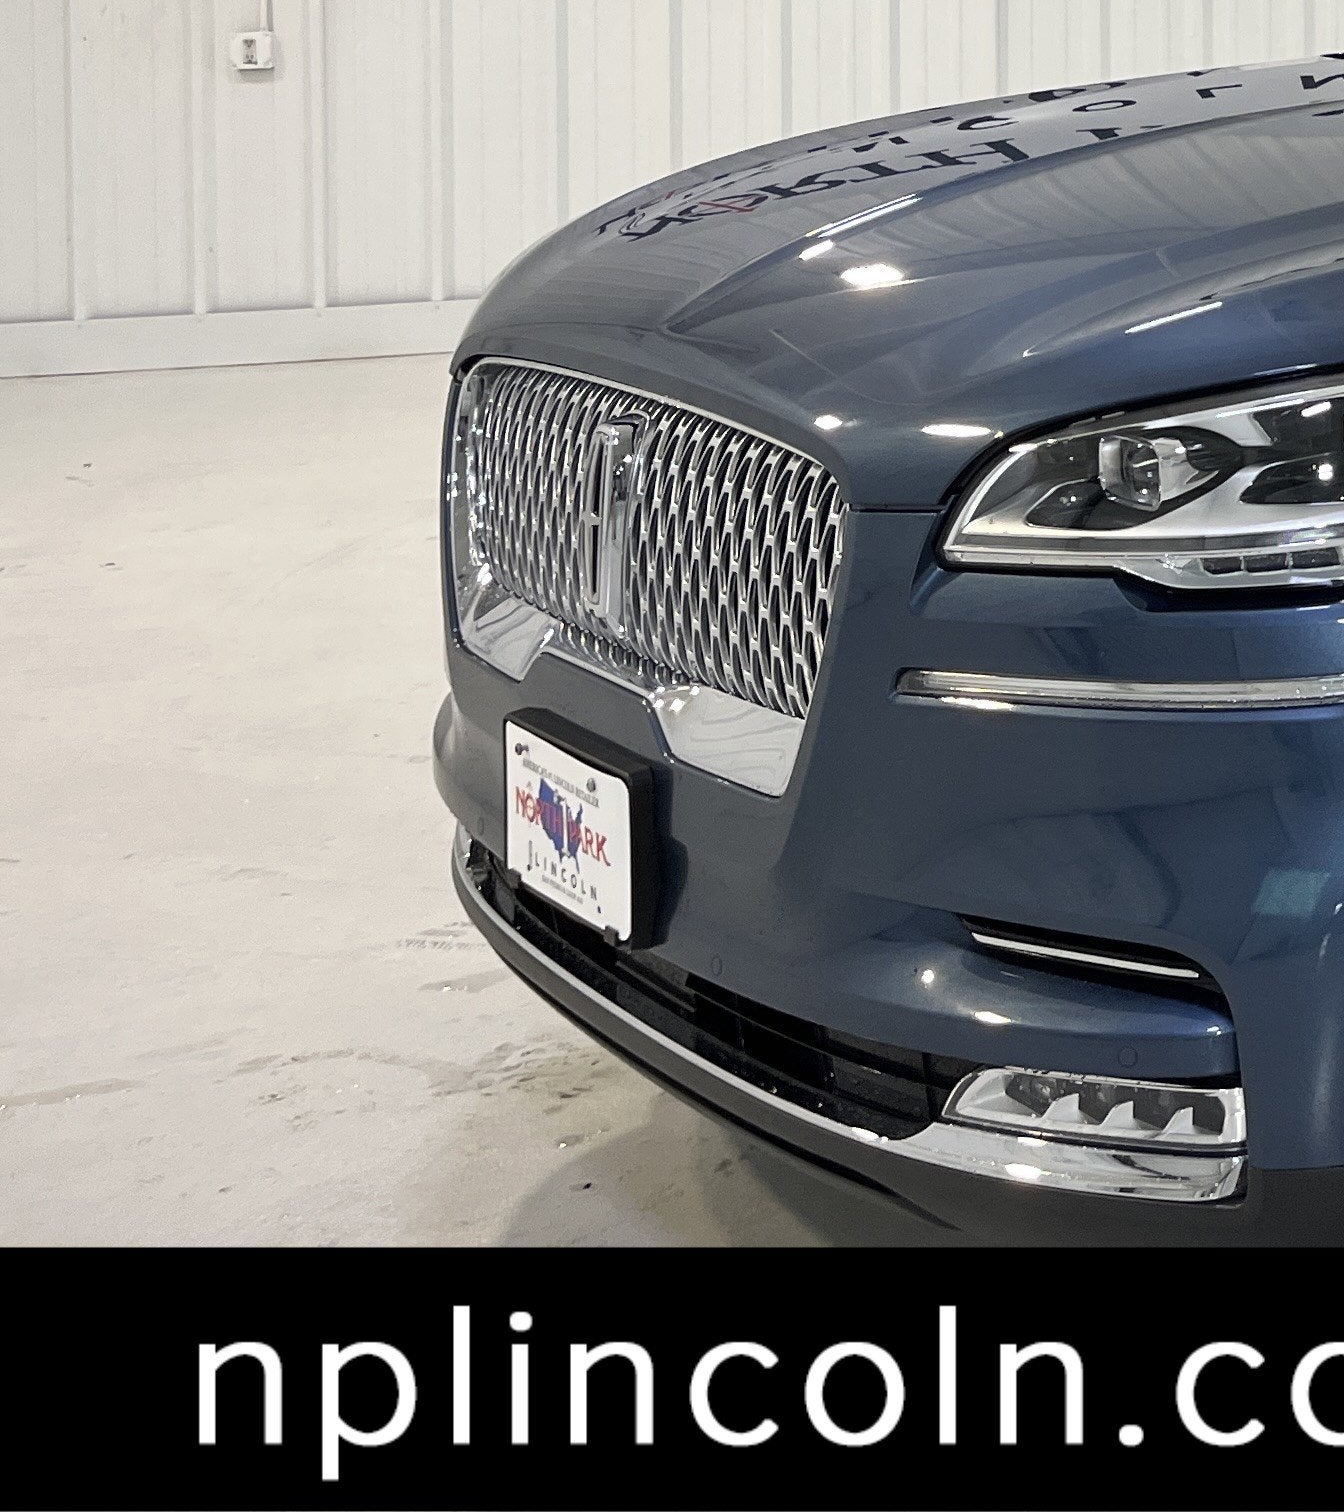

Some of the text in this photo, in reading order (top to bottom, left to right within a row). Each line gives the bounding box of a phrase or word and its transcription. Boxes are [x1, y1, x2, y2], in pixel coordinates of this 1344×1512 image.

[514, 785, 612, 867] NORTH PARK
[534, 850, 598, 901] LINCOLN
